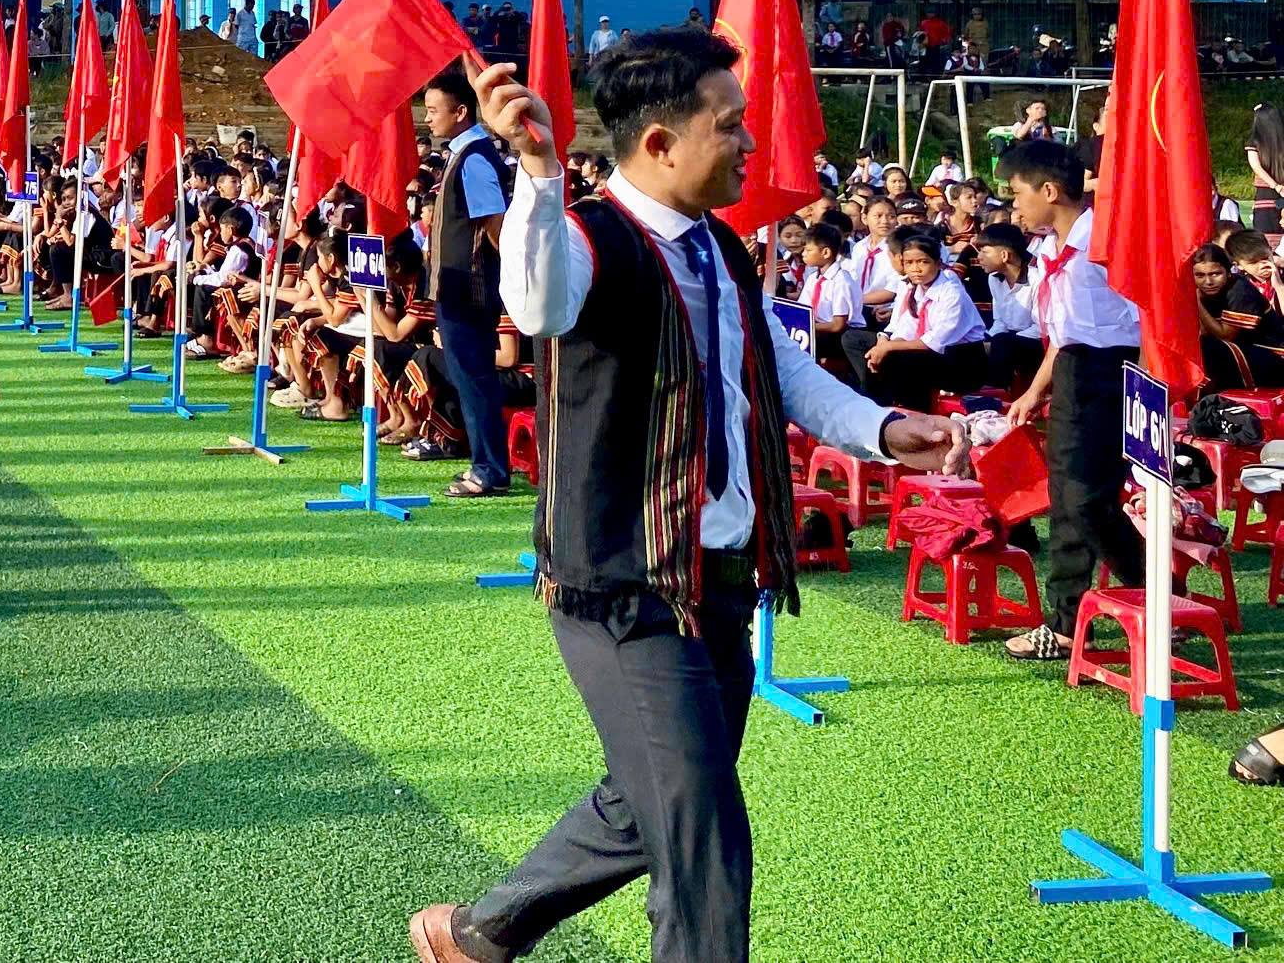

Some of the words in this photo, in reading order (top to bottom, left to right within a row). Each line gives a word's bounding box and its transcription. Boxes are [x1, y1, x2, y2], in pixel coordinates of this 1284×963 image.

[349, 246, 368, 274] LỚP
[369, 252, 385, 277] 6/4
[1125, 391, 1148, 442] LỚP
[1150, 410, 1168, 458] 6/1
